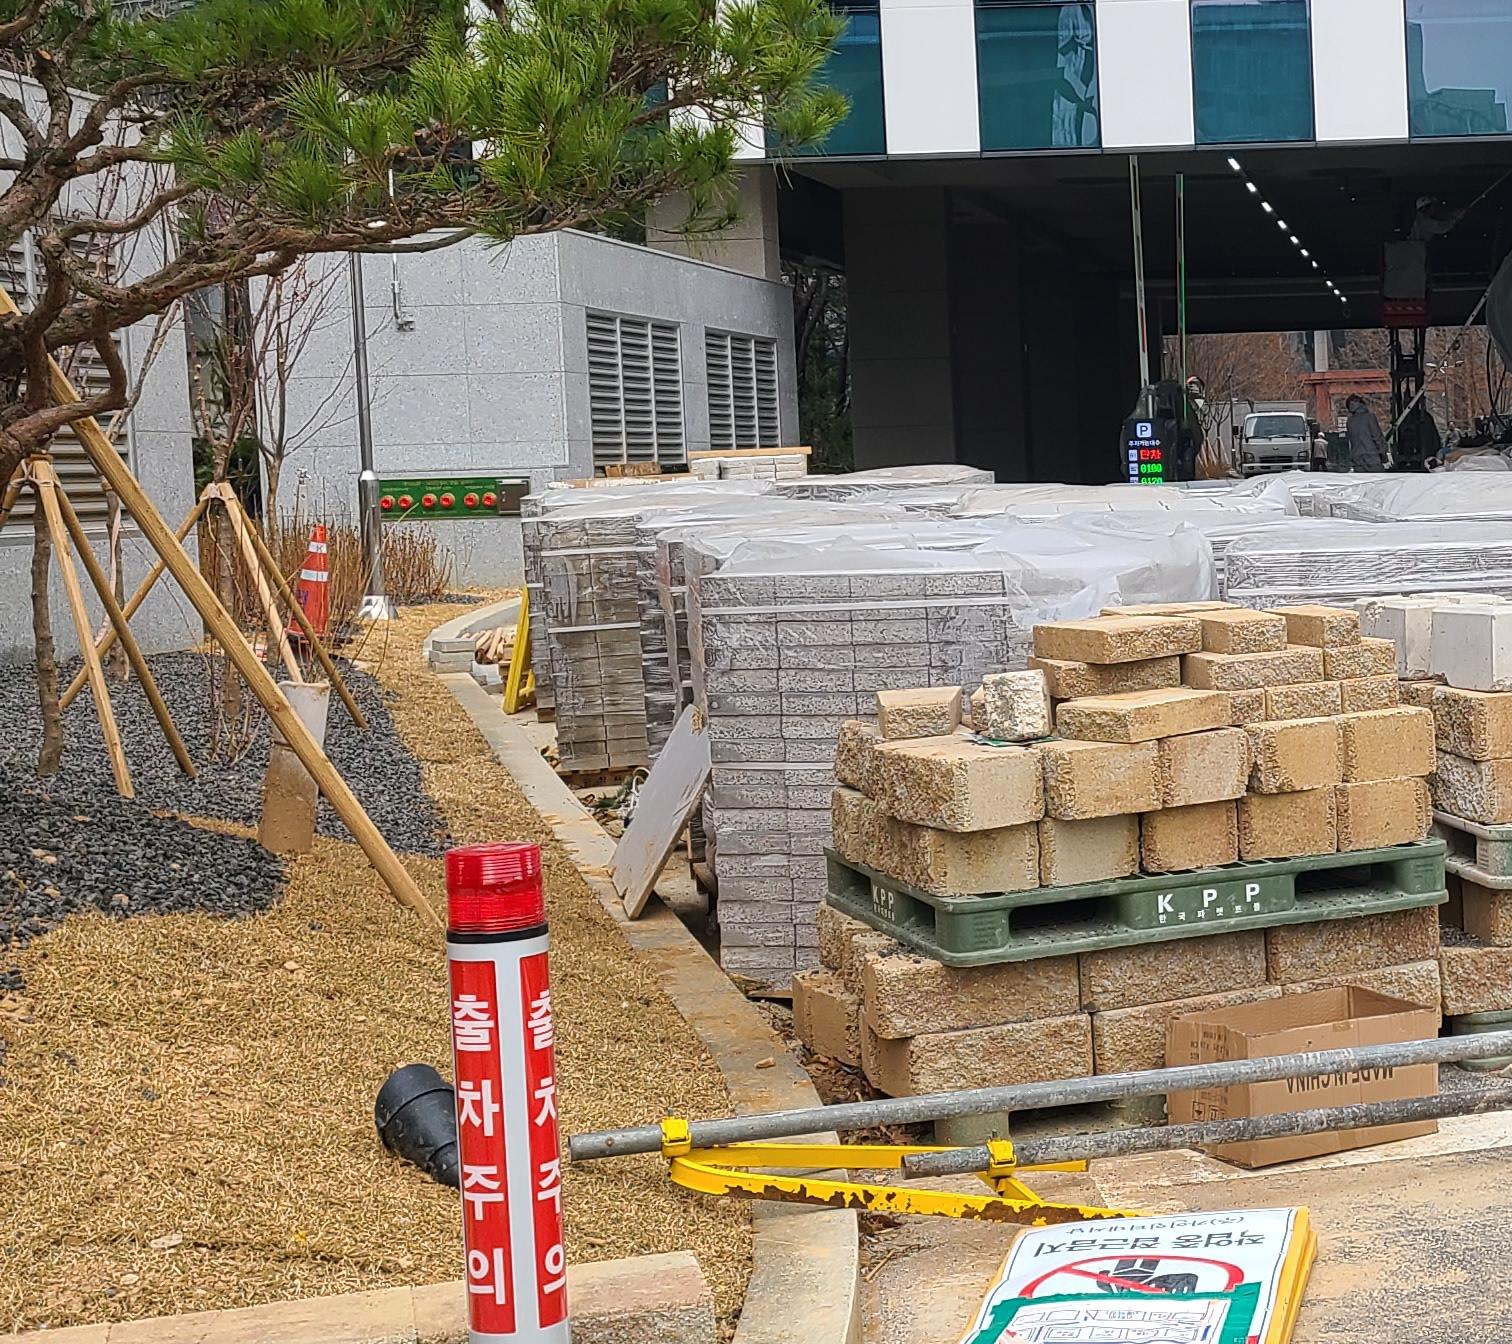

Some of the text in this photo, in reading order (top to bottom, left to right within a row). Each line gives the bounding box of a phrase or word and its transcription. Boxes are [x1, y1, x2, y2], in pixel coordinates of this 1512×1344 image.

[453, 994, 506, 1305] 출차주의
[1032, 1229, 1266, 1258] 작업중 접근금지
